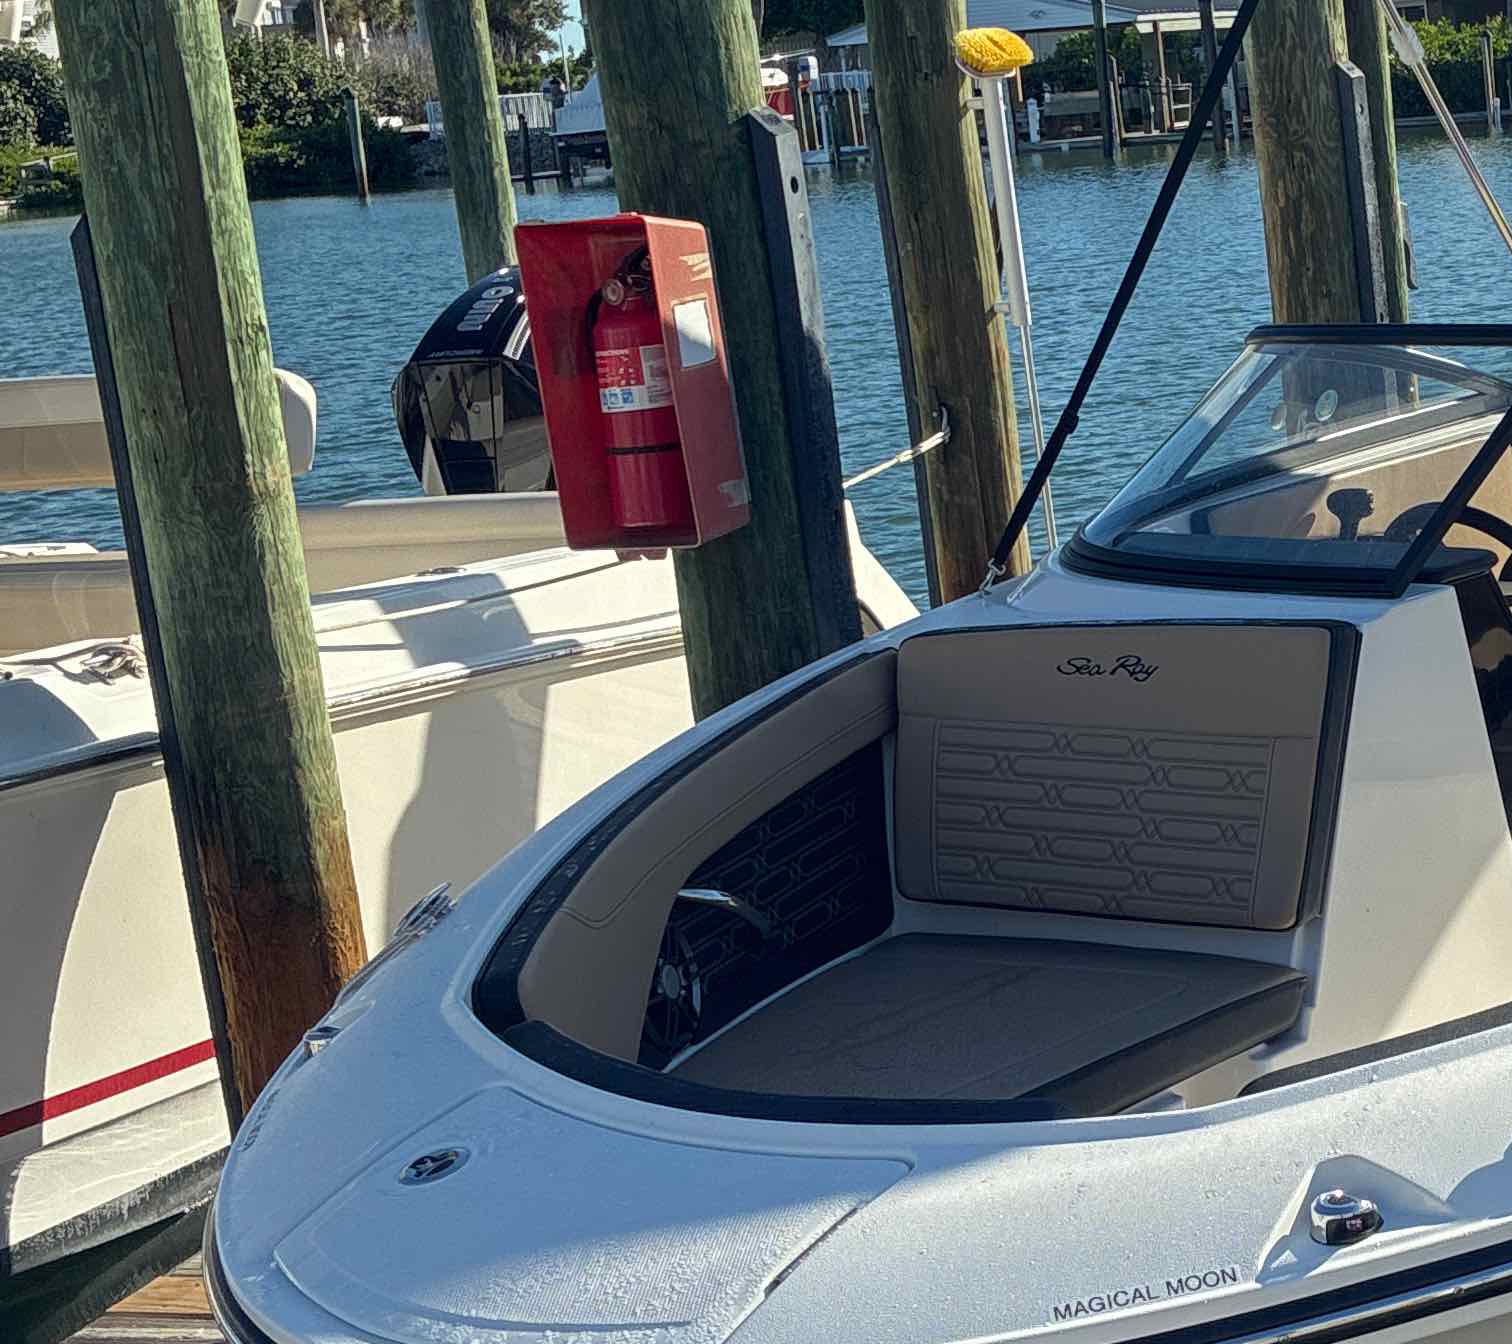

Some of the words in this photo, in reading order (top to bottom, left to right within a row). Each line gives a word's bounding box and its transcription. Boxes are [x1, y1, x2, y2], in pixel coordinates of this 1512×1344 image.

[1056, 657, 1107, 676] Sea
[1109, 654, 1160, 682] Ray
[1053, 1285, 1160, 1322] MAGICAL
[1165, 1266, 1238, 1297] MOON
